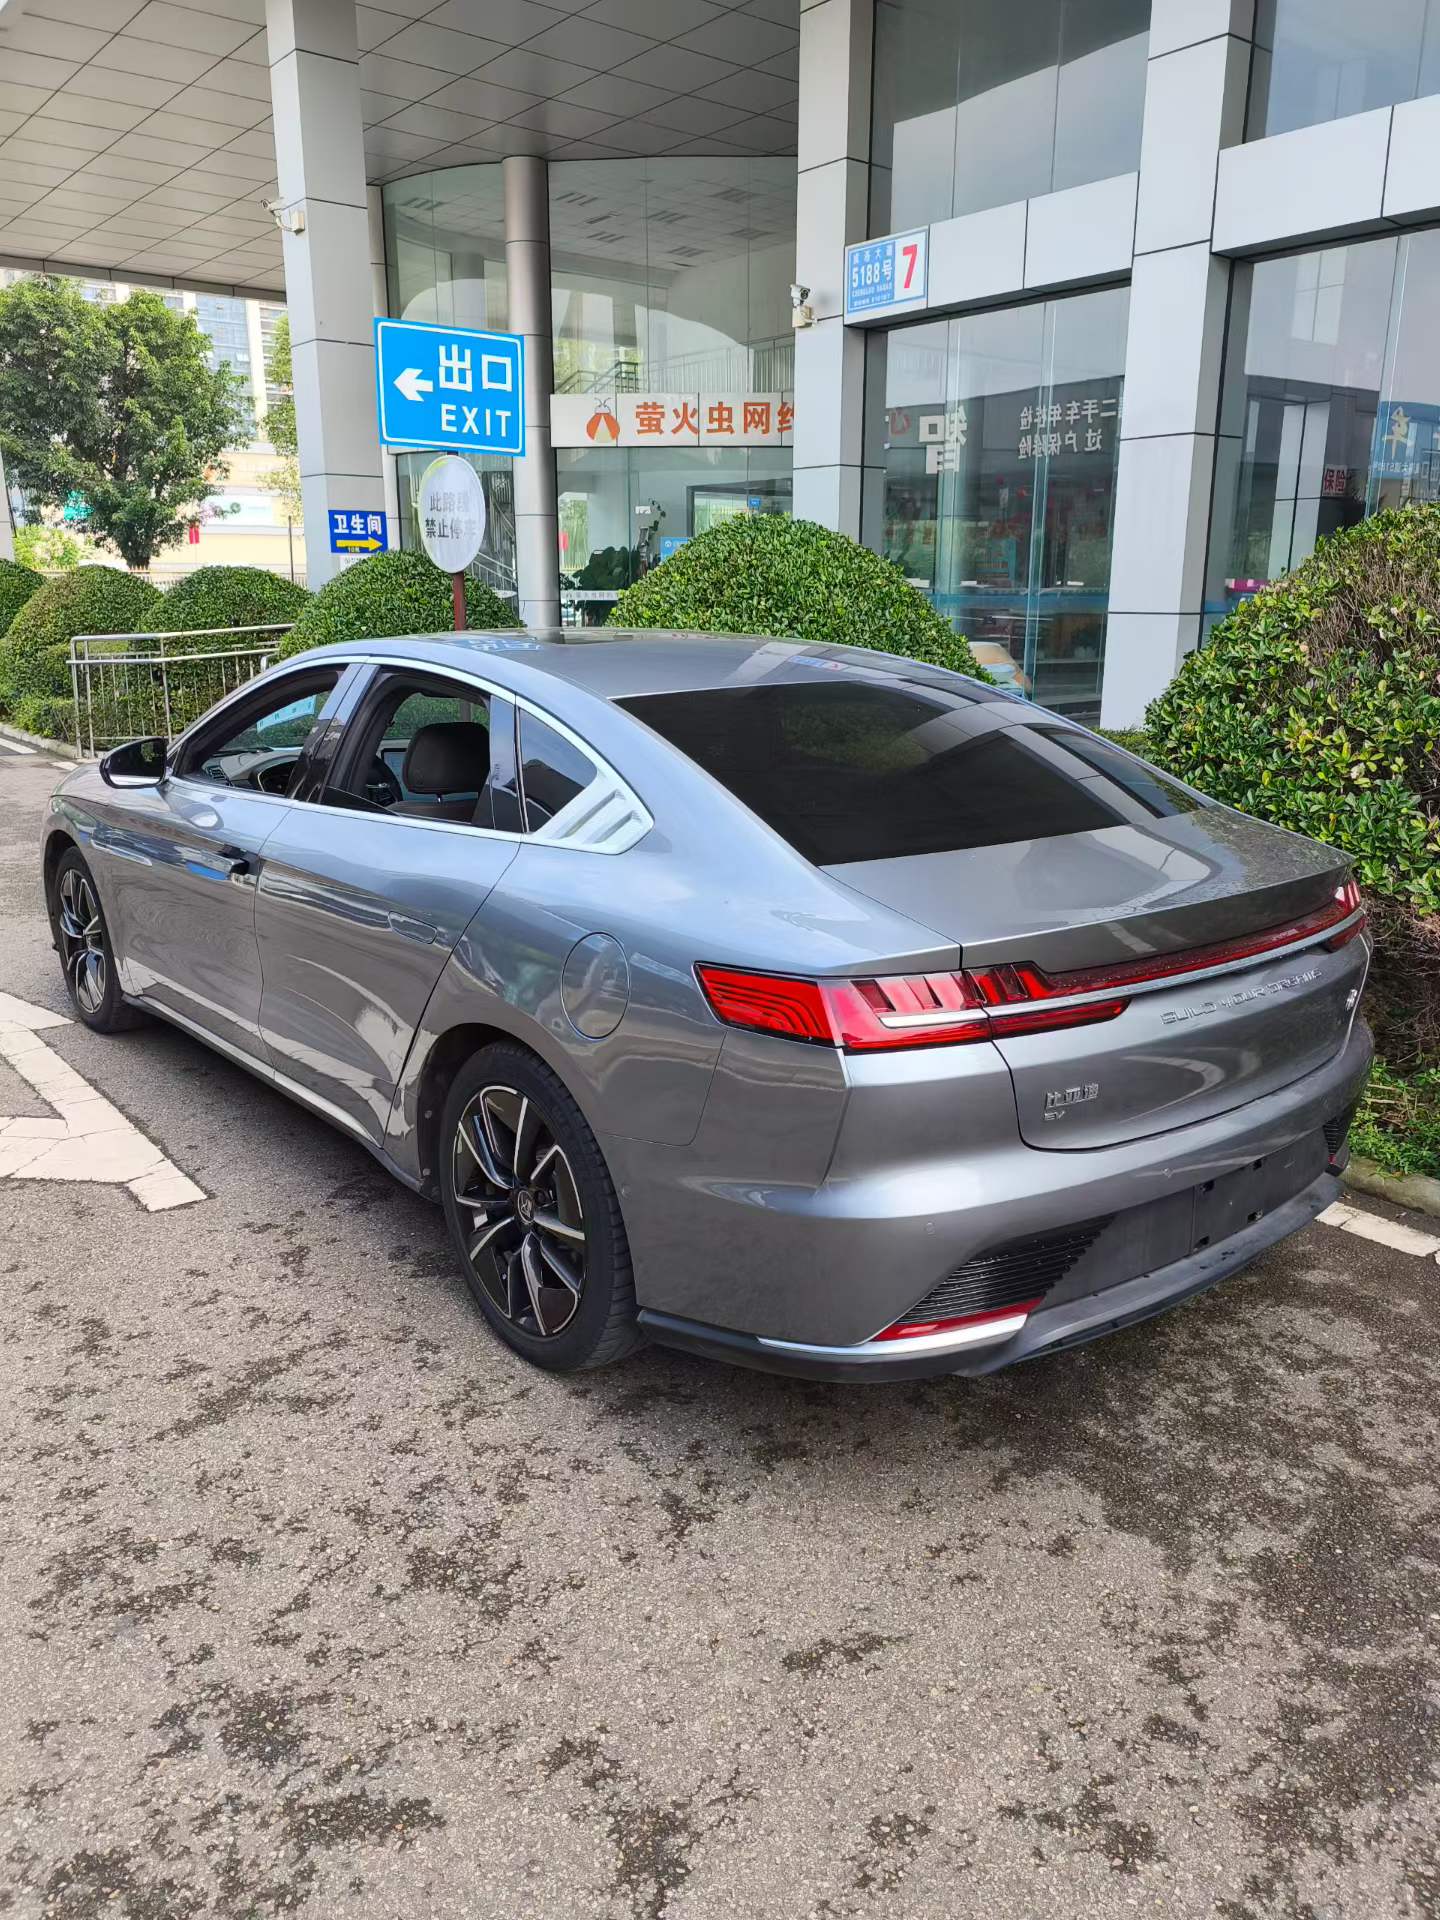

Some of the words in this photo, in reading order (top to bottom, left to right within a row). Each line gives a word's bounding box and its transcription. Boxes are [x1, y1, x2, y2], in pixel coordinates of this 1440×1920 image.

[852, 258, 893, 288] 5188号
[902, 244, 918, 289] 7
[438, 344, 512, 392] 出口
[441, 403, 511, 438] EXIT
[1324, 469, 1345, 492] 保险
[334, 514, 382, 535] 卫生间
[425, 517, 477, 540] 禁止停车
[1046, 1083, 1099, 1109] 比亚迪
[1044, 1110, 1065, 1121] EV
